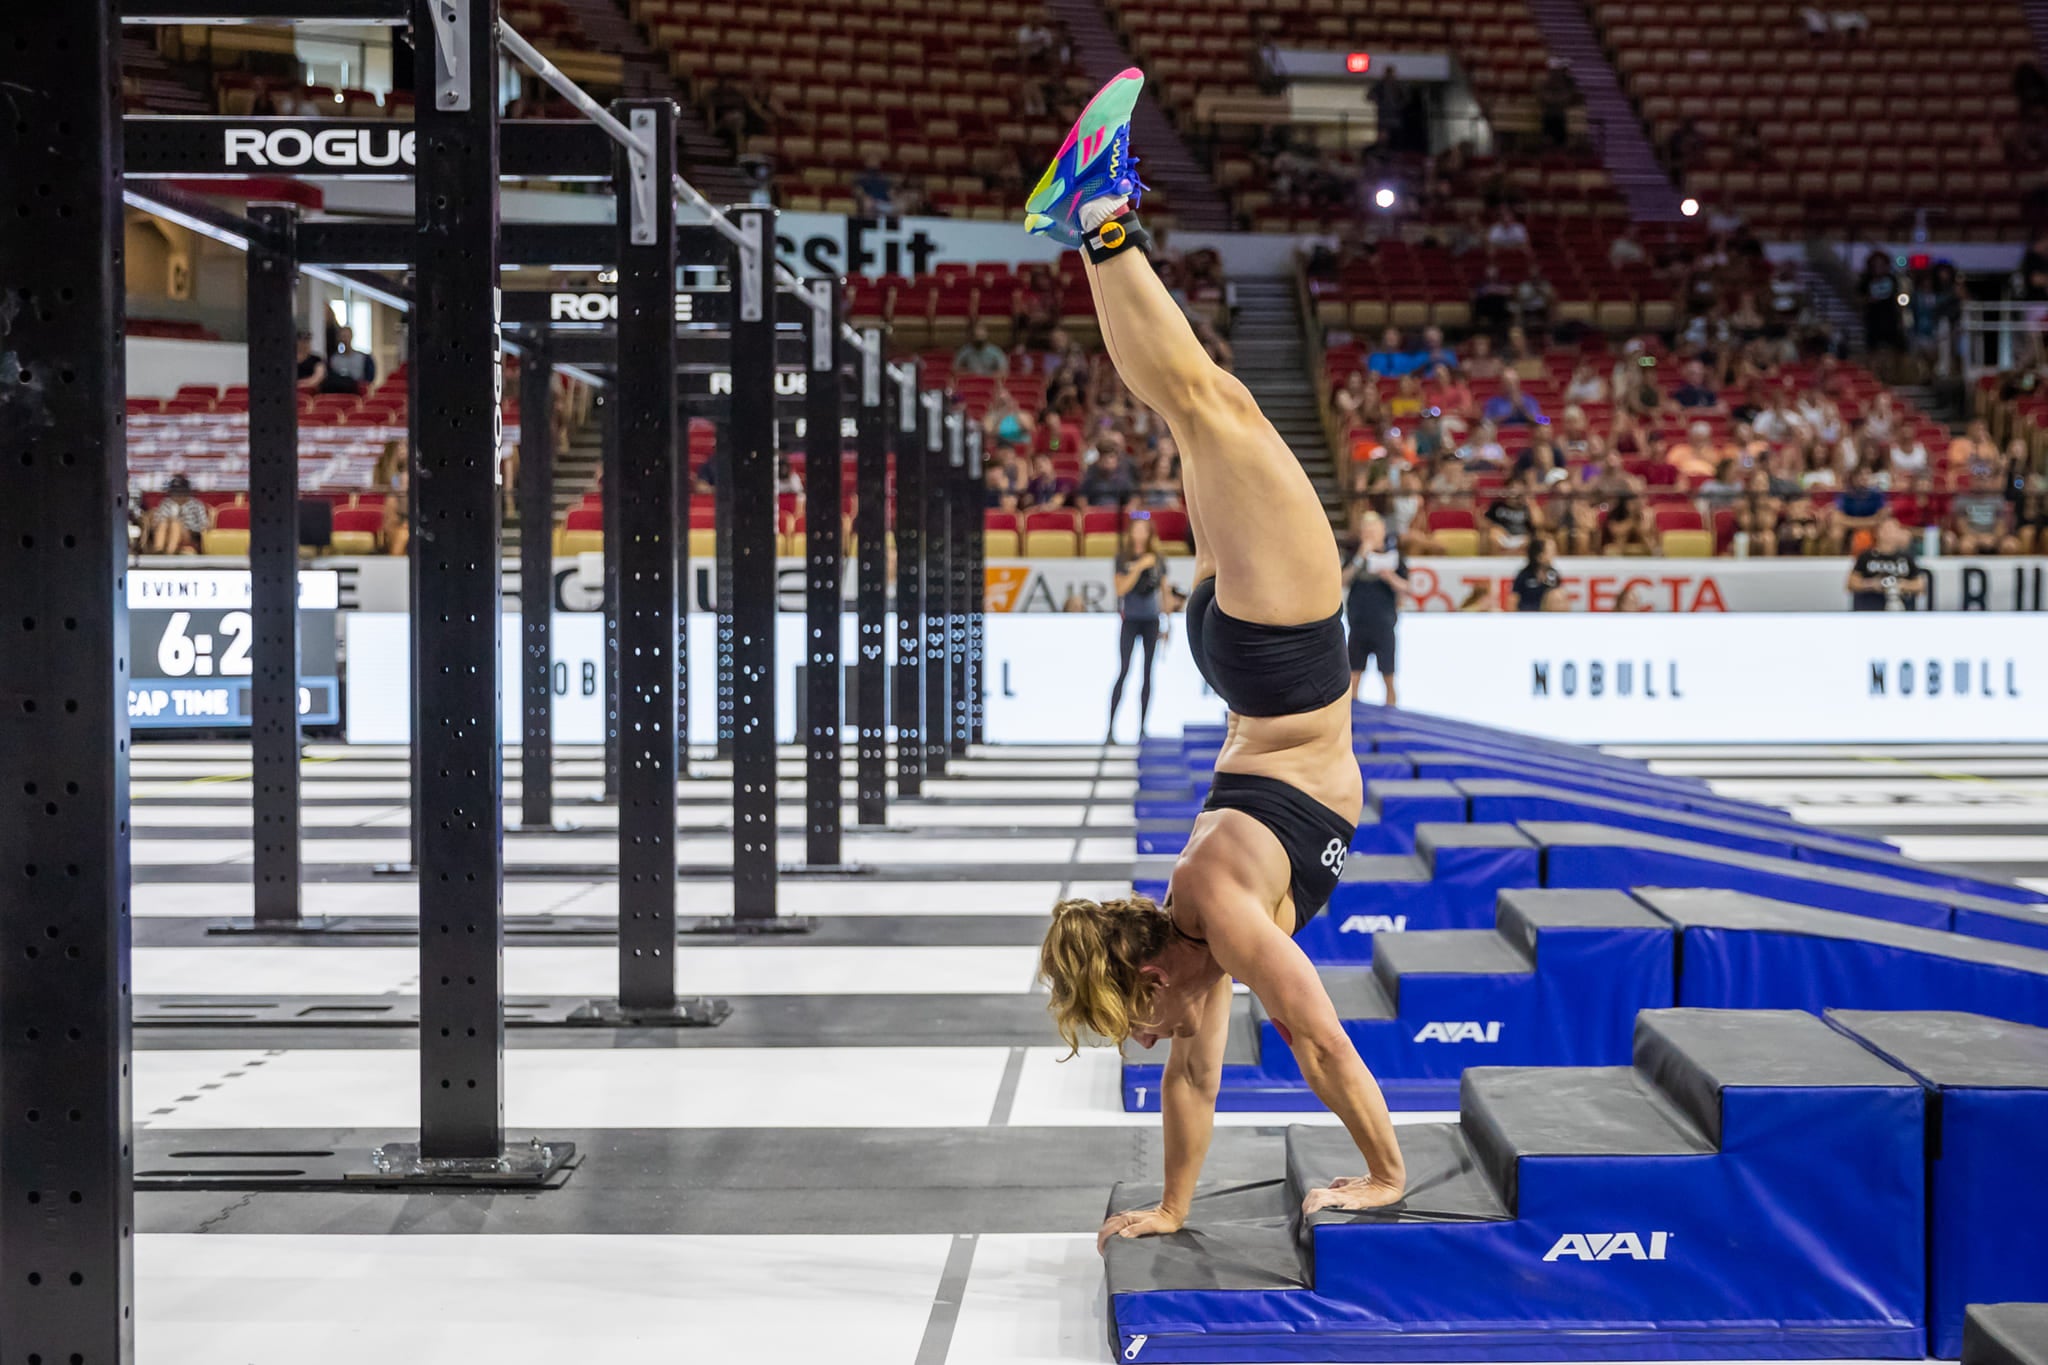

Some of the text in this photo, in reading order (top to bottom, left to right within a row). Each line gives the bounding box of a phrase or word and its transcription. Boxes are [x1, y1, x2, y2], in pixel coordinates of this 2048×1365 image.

[551, 293, 692, 321] ROE
[494, 286, 502, 485] ROGUE
[1533, 661, 1681, 696] NOBULL
[1871, 661, 2018, 697] NOBULL
[171, 689, 229, 716] TIME
